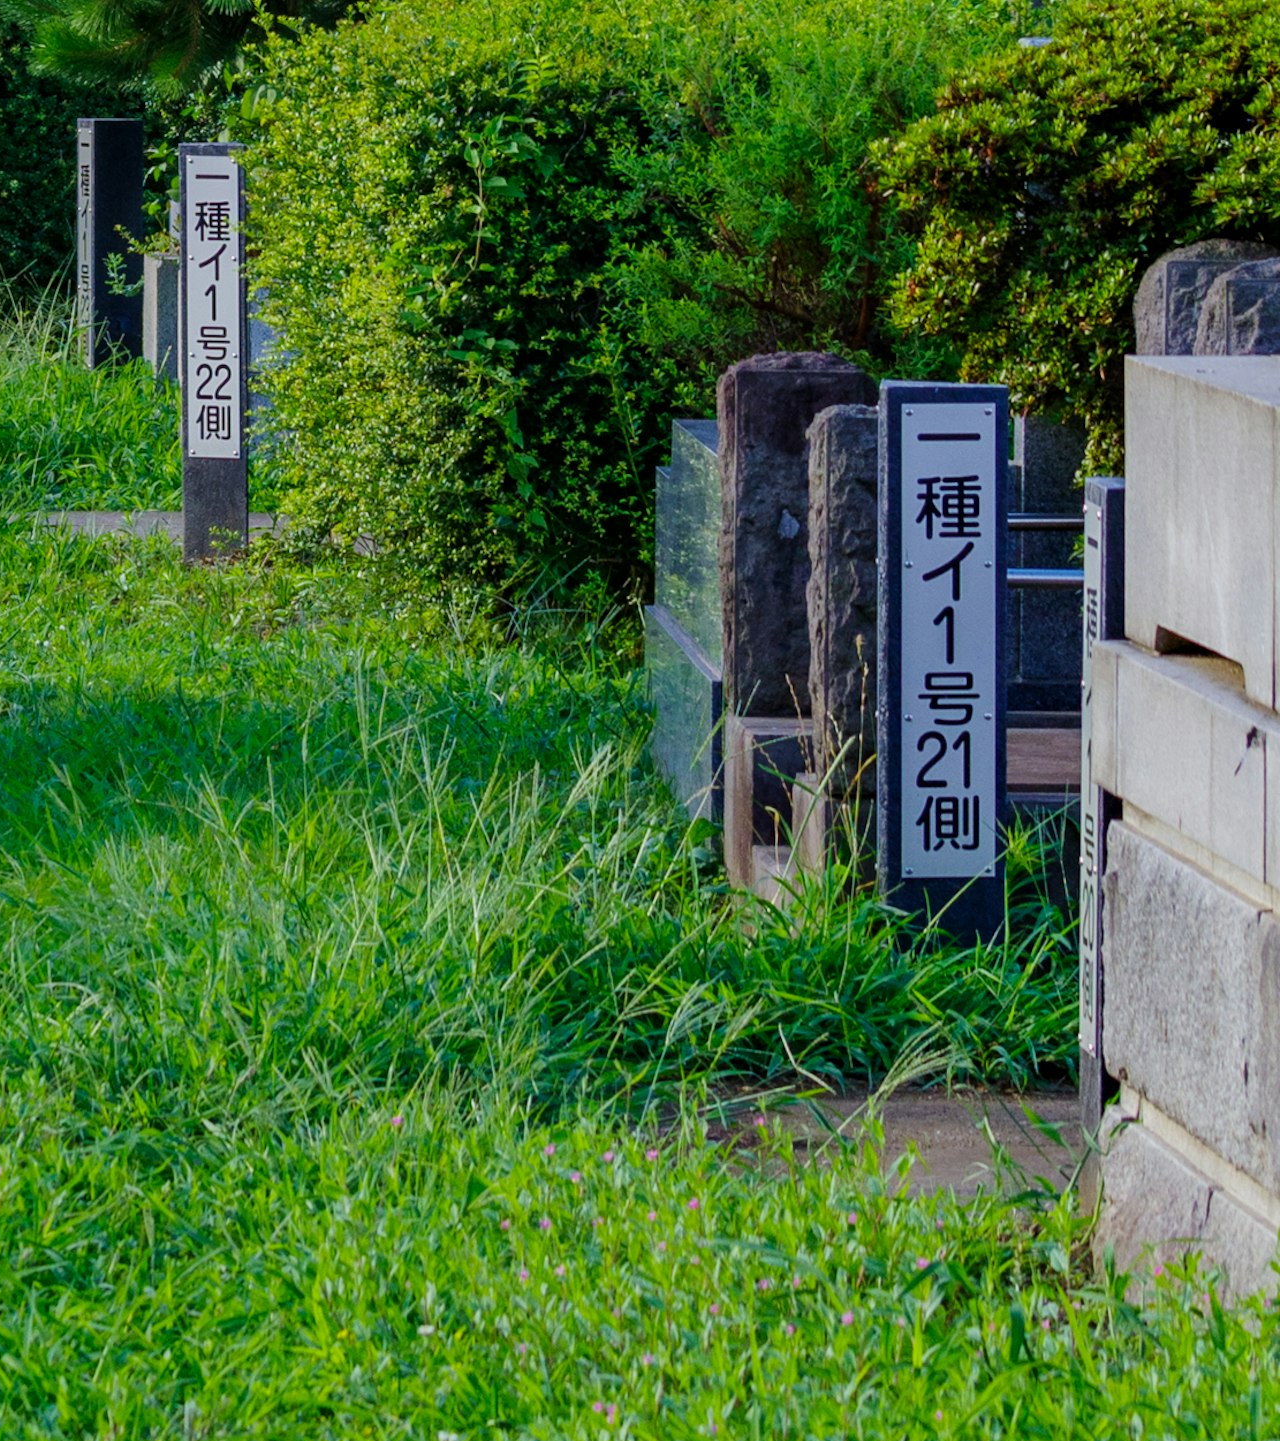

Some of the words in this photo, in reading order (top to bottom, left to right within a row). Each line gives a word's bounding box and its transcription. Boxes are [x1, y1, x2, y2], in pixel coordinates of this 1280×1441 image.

[195, 173, 232, 441] 一種イ1号22側
[915, 431, 982, 853] 一種イ1号21側
